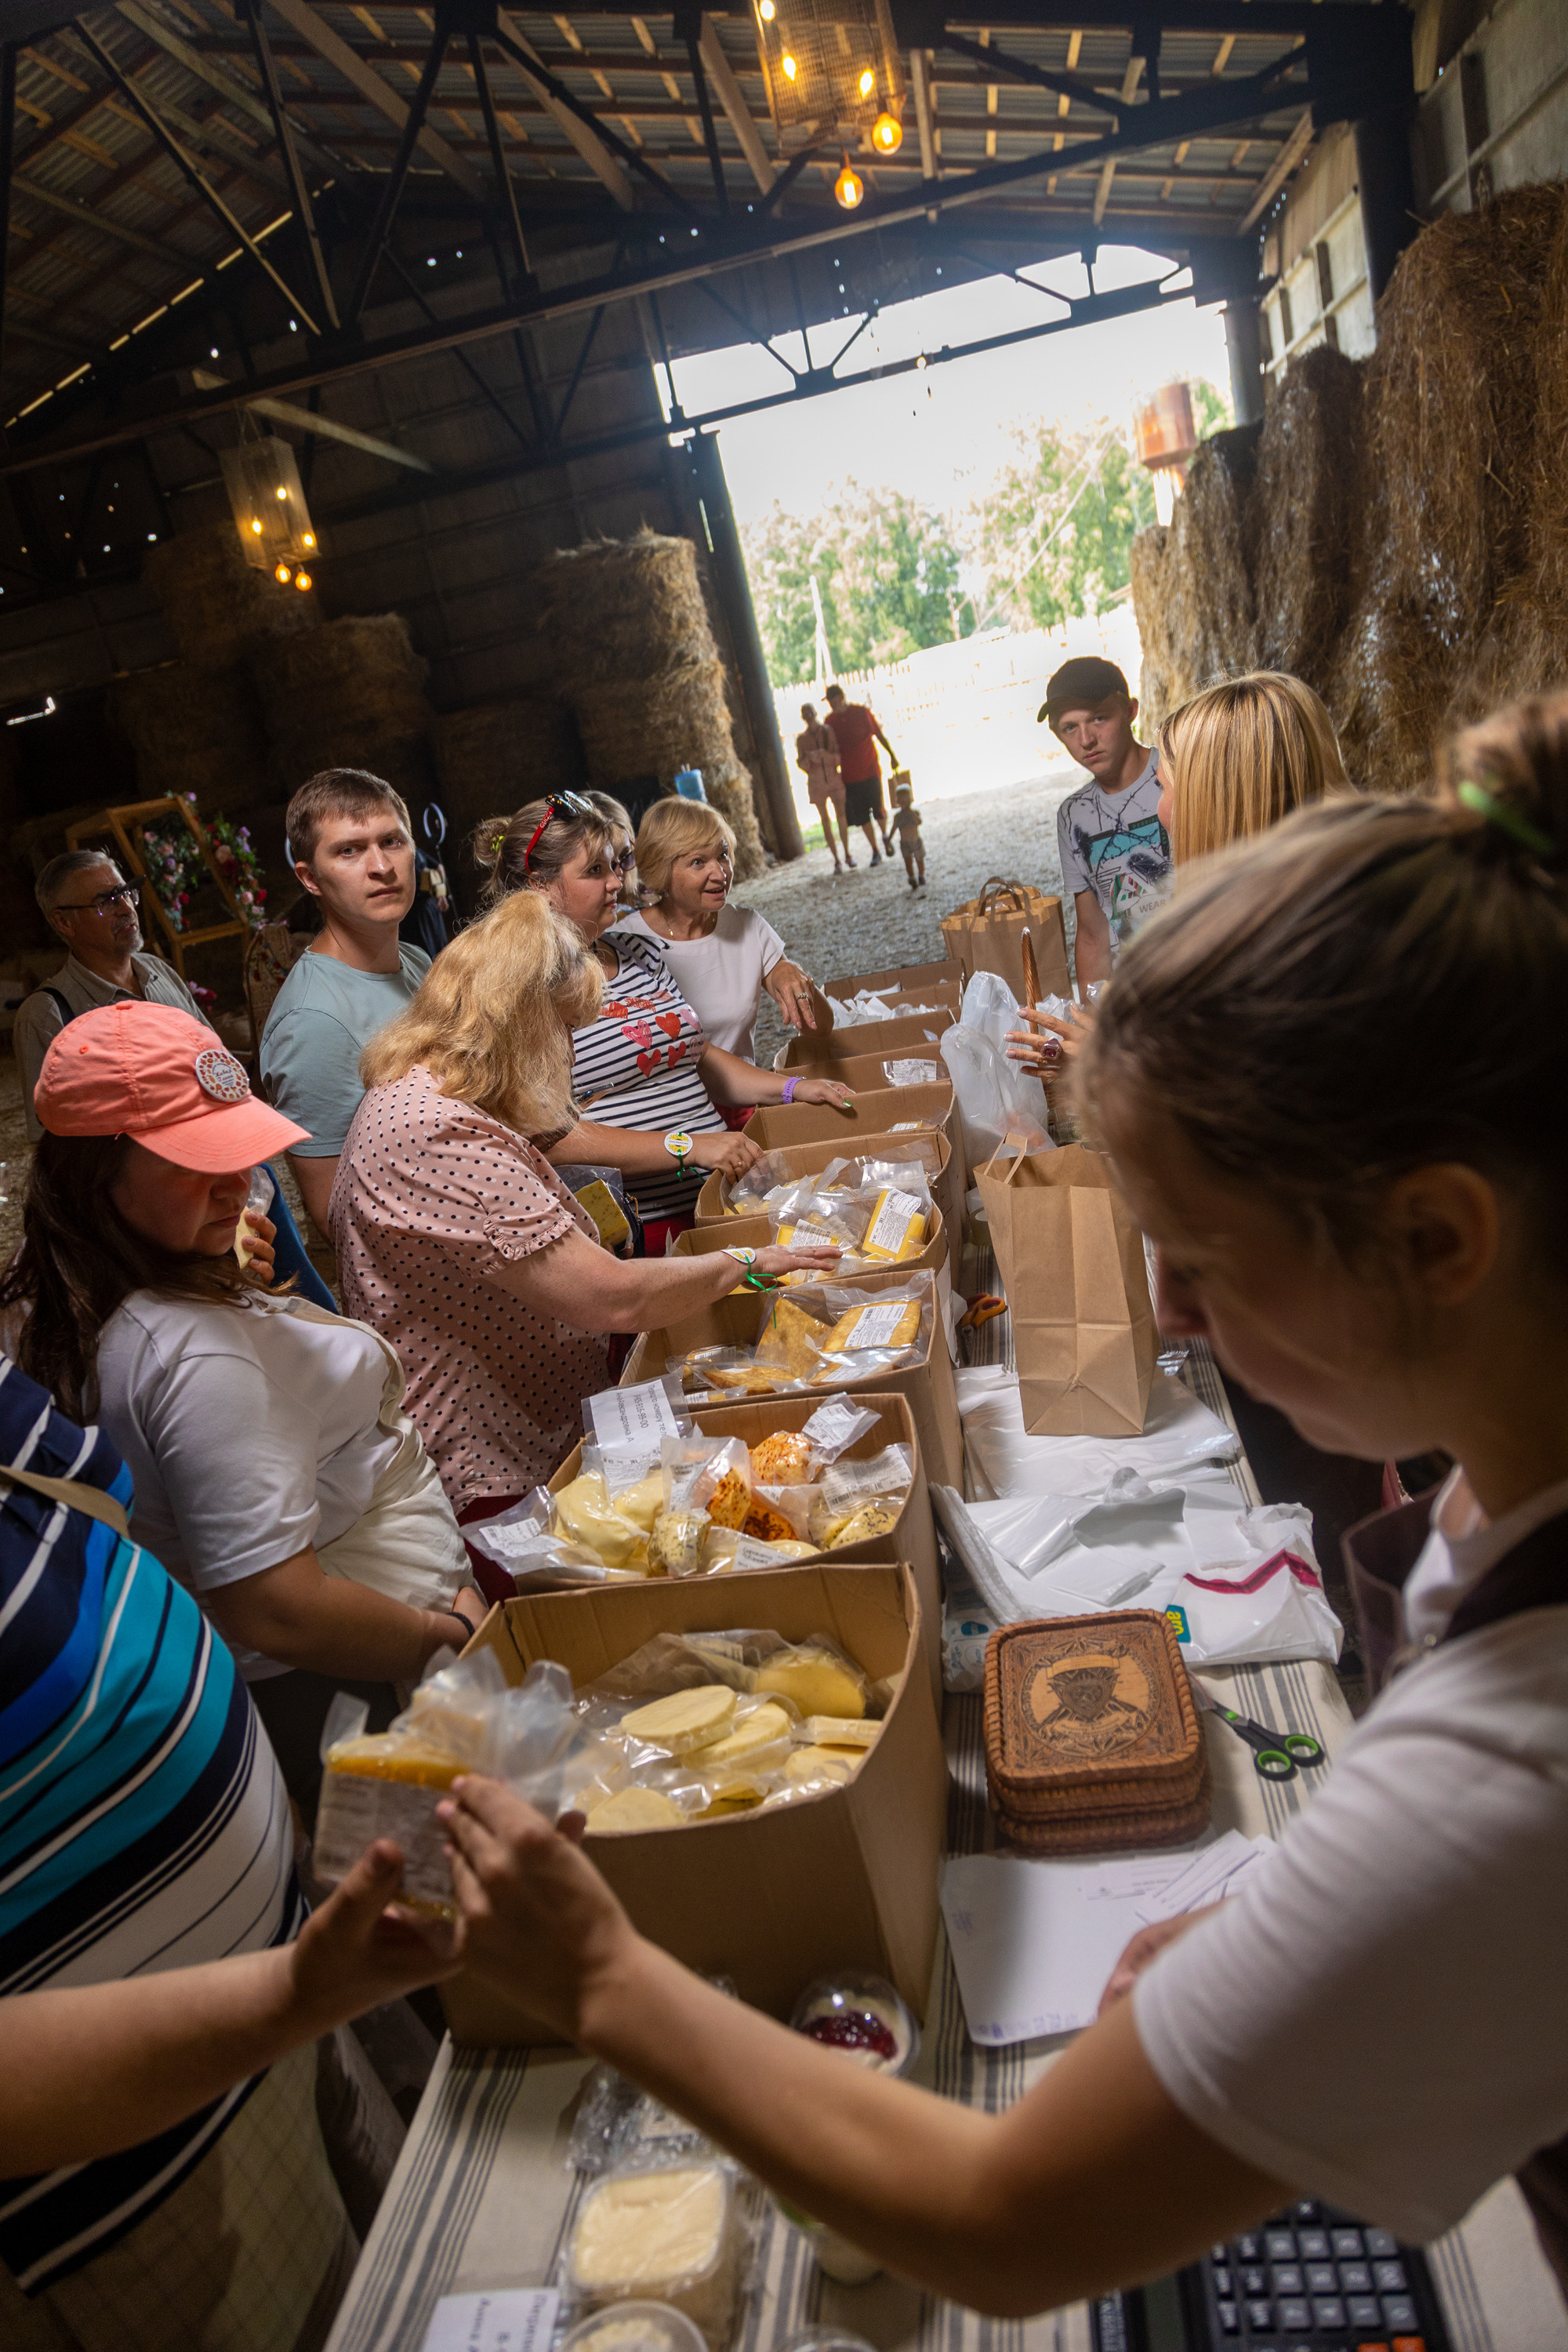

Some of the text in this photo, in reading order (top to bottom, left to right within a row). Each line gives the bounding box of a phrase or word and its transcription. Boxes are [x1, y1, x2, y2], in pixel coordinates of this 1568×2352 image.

[1138, 899, 1167, 913] WEAR
[653, 1403, 663, 1422] номеру
[1166, 1611, 1185, 1635] aro
